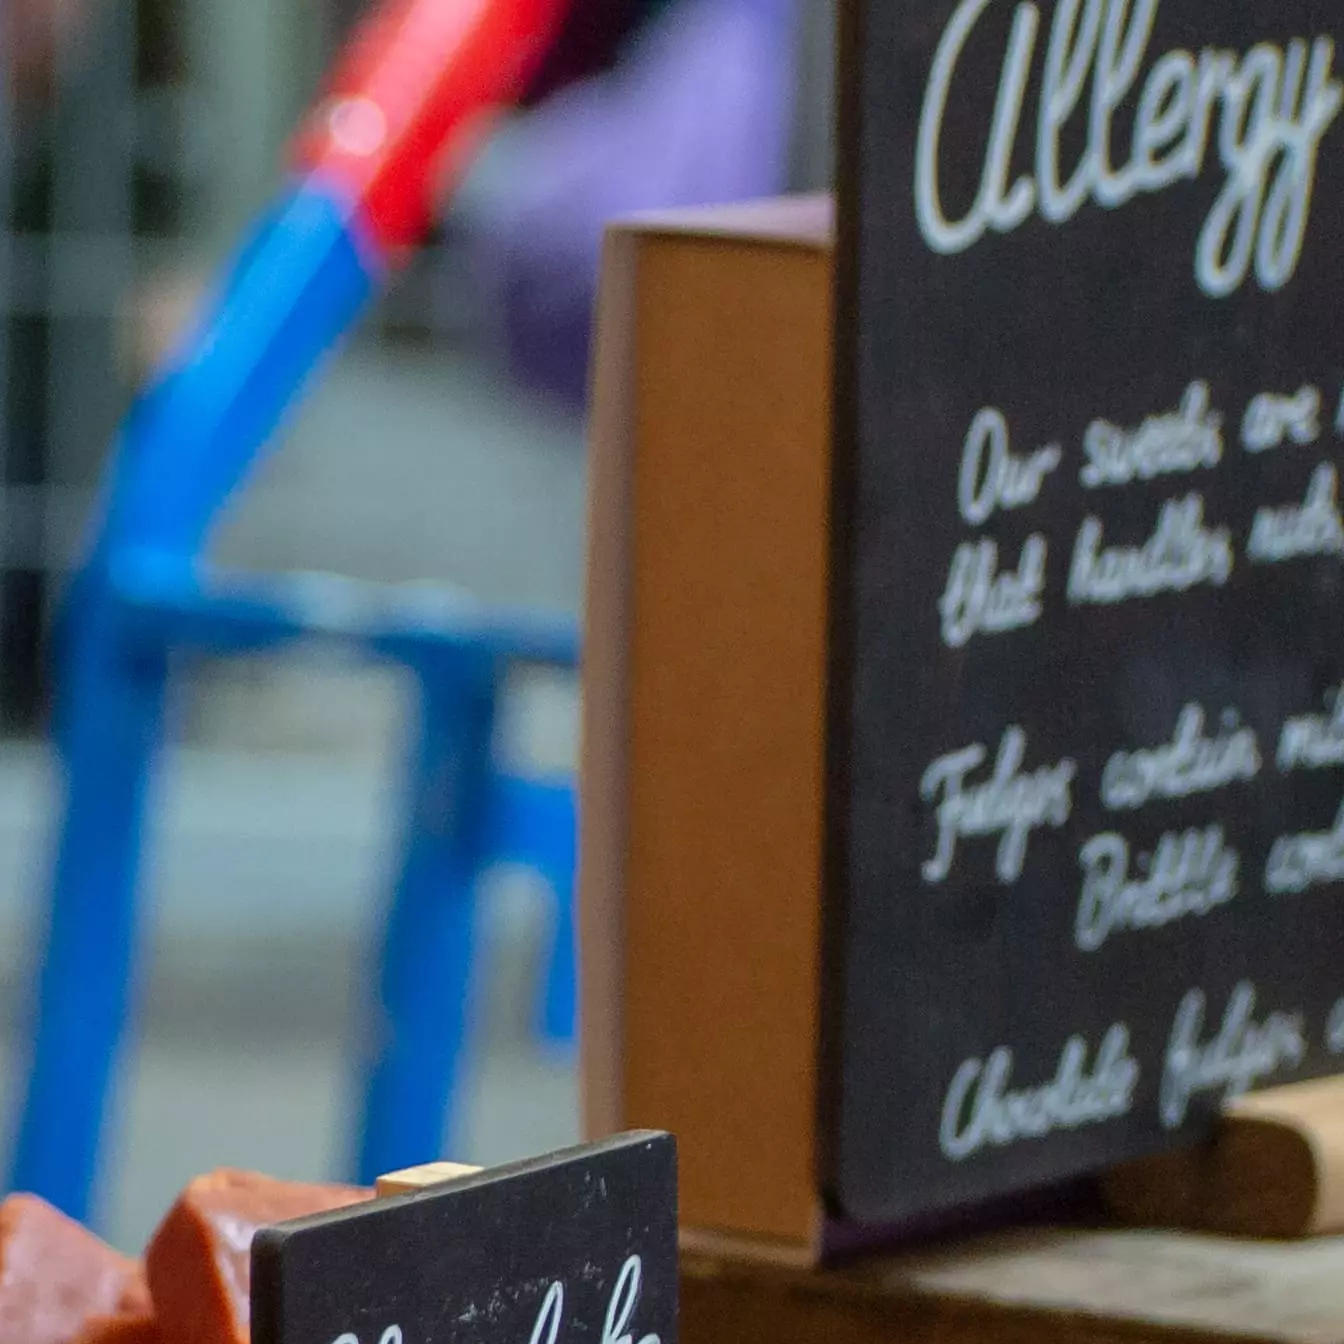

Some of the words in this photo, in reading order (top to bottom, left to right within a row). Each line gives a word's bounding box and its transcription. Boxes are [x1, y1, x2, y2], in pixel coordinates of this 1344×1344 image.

[958, 407, 1062, 525] Our
[1080, 381, 1222, 487] sweets
[1241, 386, 1320, 451] are
